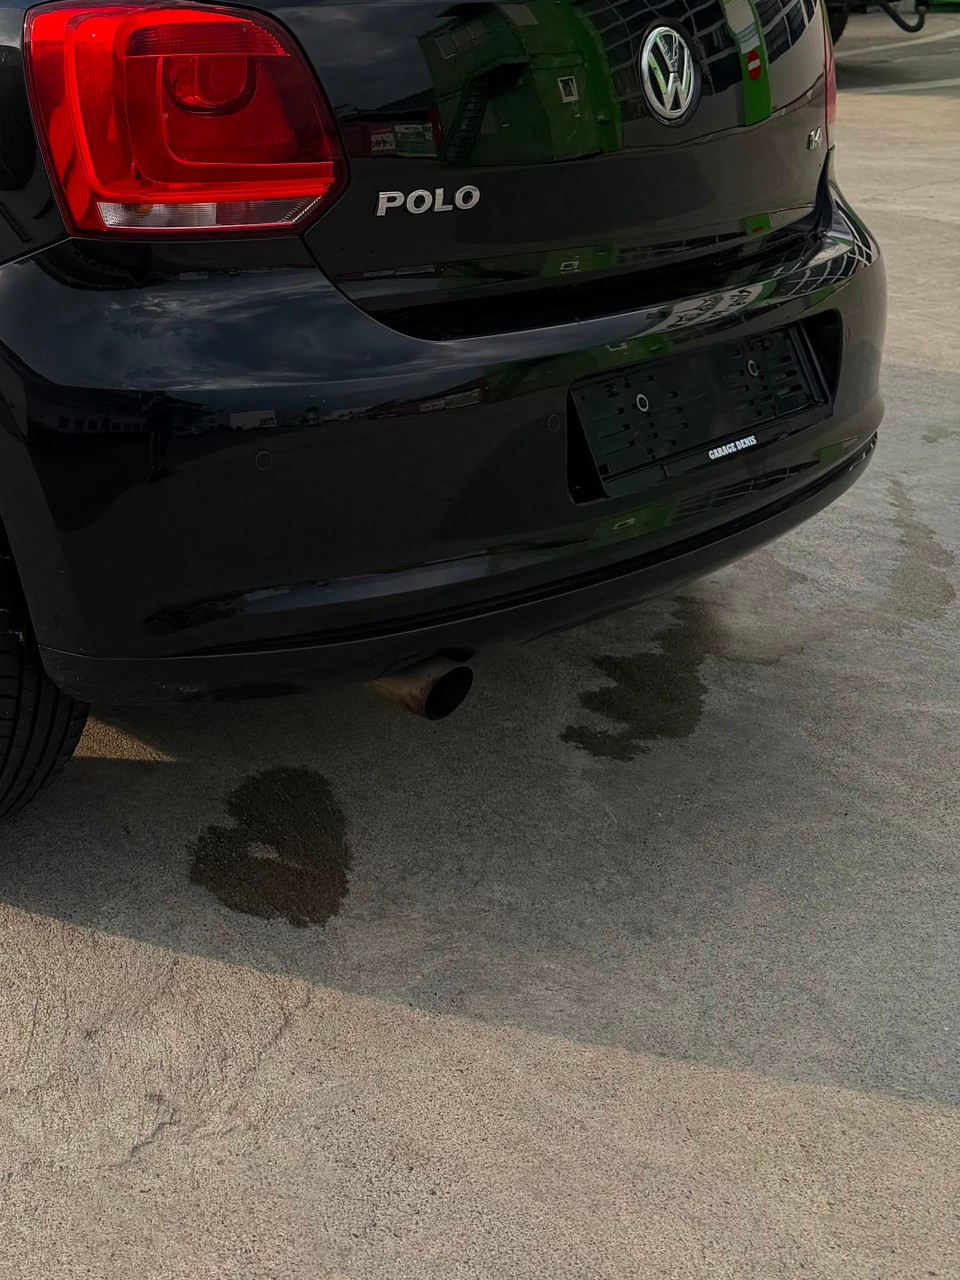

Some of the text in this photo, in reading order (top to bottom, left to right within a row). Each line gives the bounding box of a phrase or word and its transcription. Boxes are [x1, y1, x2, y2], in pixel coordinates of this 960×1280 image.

[376, 184, 481, 216] POLO
[708, 435, 757, 460] GARAGE DENIS
